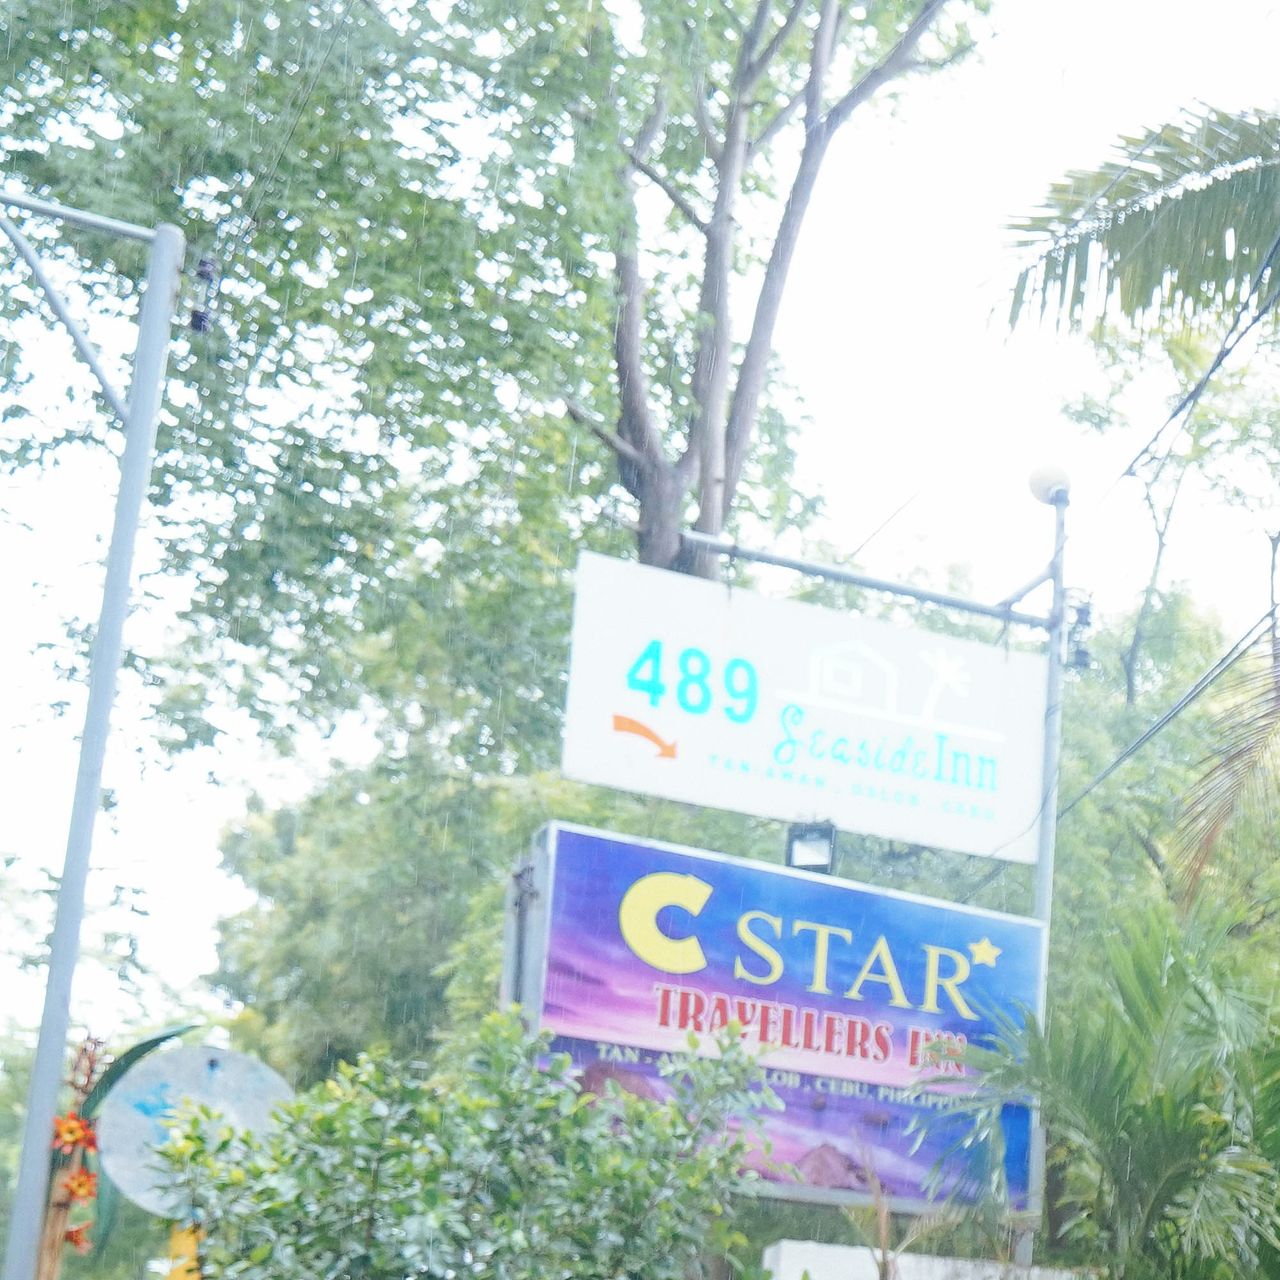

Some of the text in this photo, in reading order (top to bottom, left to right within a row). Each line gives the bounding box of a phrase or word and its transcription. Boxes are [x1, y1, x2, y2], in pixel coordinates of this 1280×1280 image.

[626, 639, 759, 724] 489
[618, 872, 981, 1021] C STAR
[655, 984, 893, 1062] TRAVELLERS
